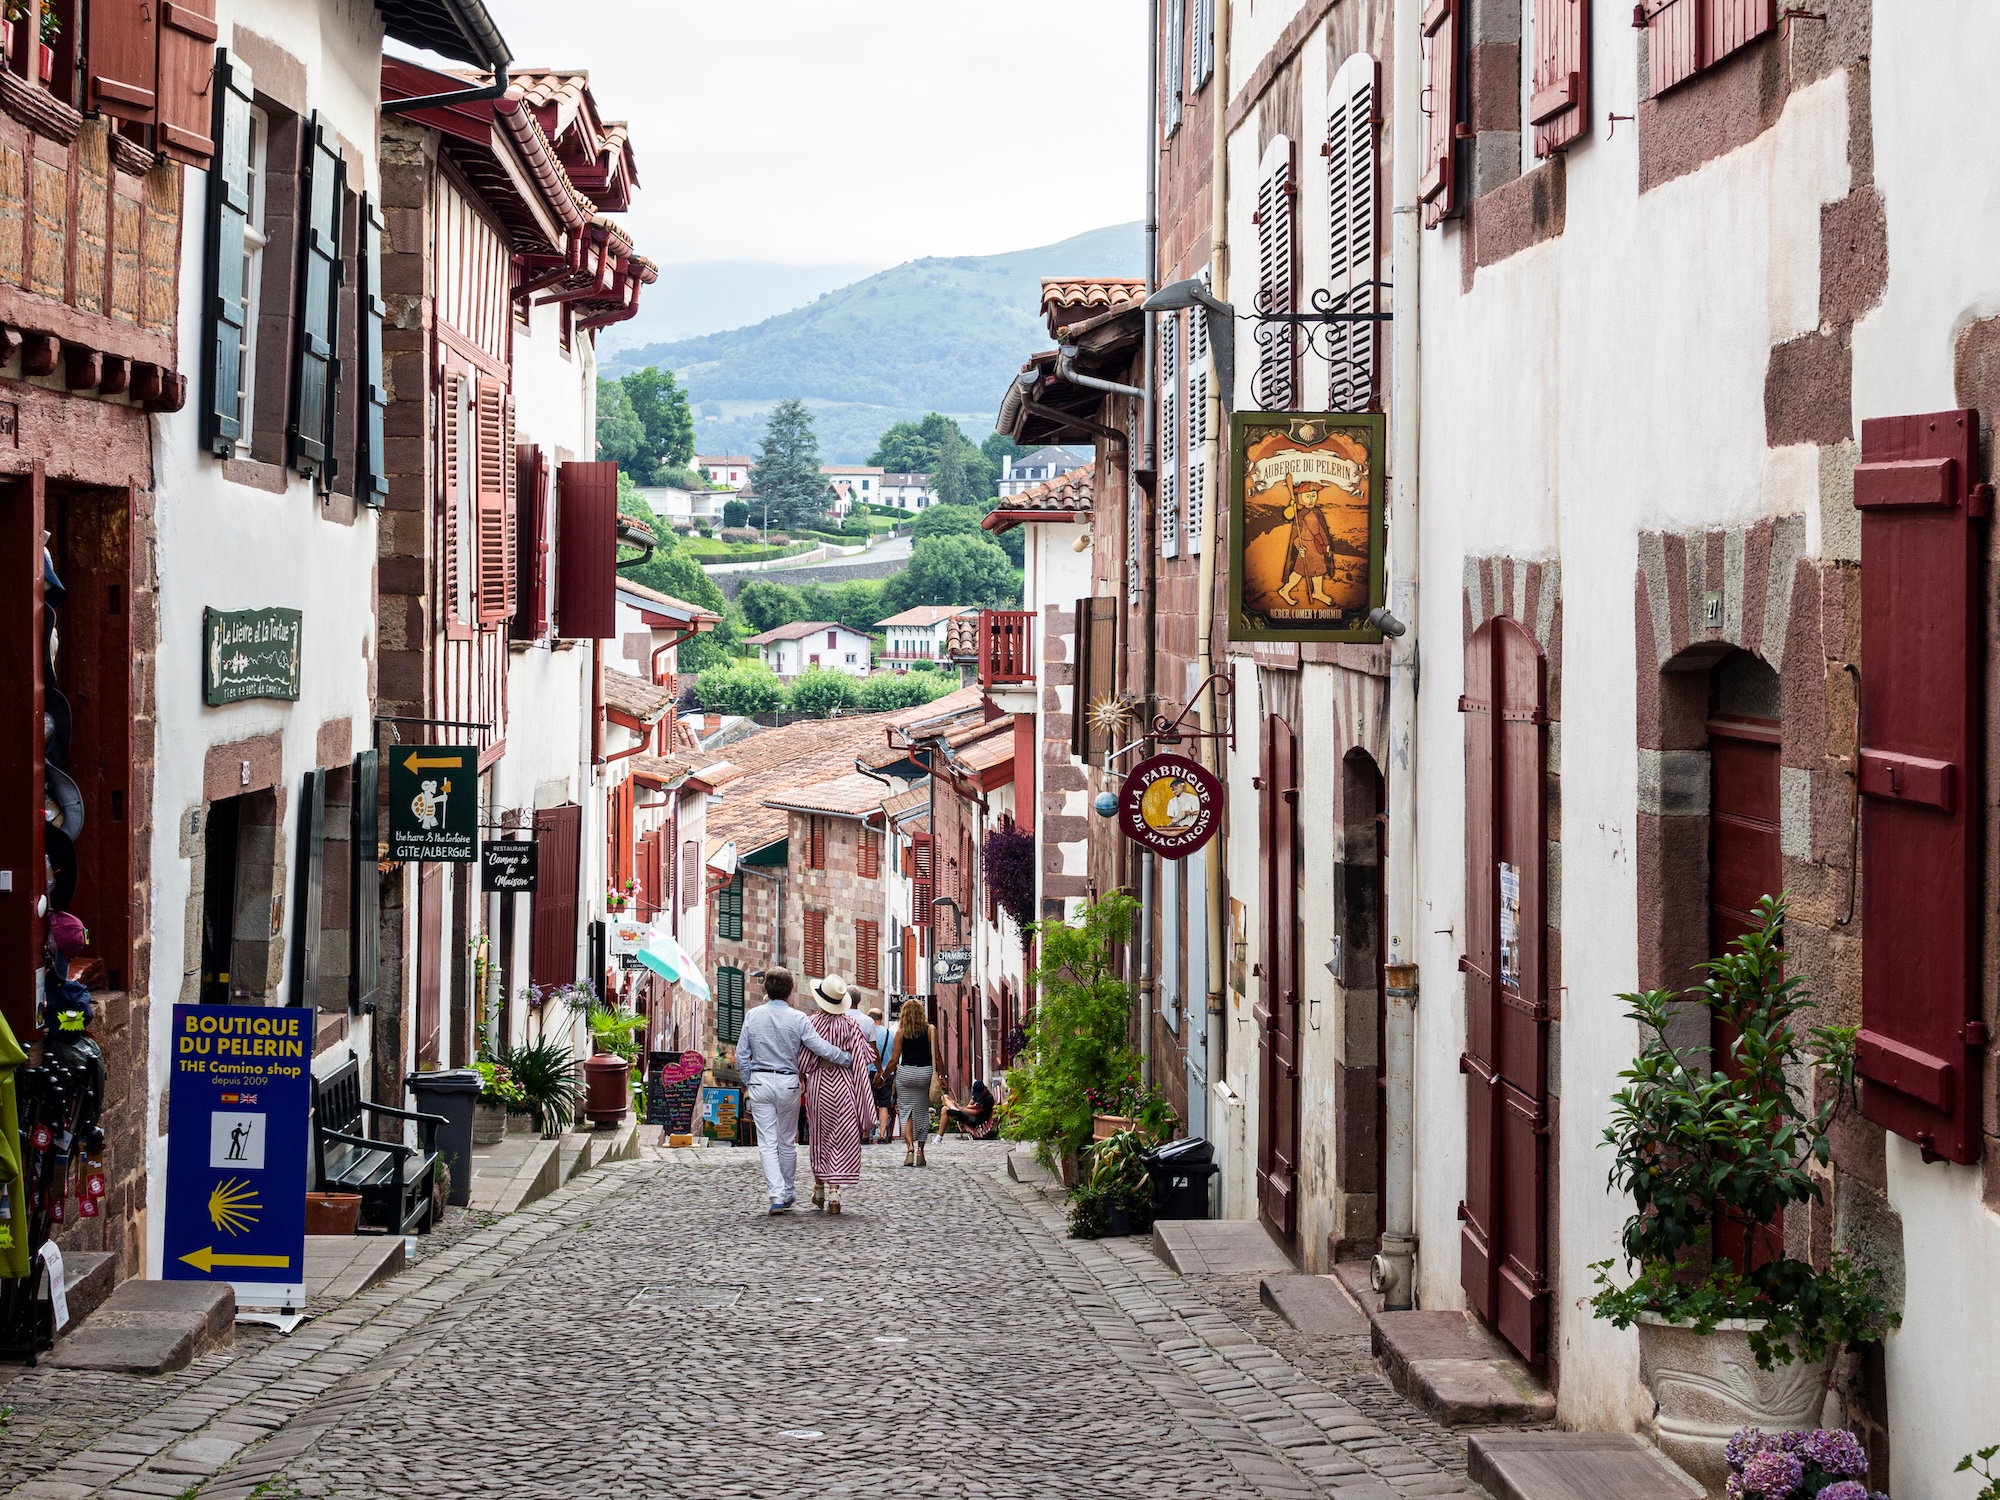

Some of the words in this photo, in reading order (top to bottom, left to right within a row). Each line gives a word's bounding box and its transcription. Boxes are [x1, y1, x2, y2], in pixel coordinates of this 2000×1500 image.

[1264, 459, 1301, 480] AUBERGE
[1303, 459, 1314, 472] DU
[1316, 459, 1351, 480] PELERIN
[1292, 609, 1312, 619] COMER
[1313, 609, 1317, 619] Y
[1318, 609, 1342, 619] DORMIR
[1708, 600, 1718, 618] 27
[223, 622, 231, 645] Le
[232, 622, 253, 643] Lièvre
[254, 621, 261, 643] et
[262, 620, 269, 642] La
[270, 618, 289, 642] Tortue
[258, 683, 265, 694] de
[1129, 789, 1143, 810] LA
[1141, 765, 1211, 803] FABRIQUE
[1132, 813, 1146, 832] DE
[1144, 809, 1211, 847] MACARONS
[445, 832, 471, 843] tortoise
[521, 854, 530, 865] à
[506, 864, 517, 875] la
[937, 951, 972, 960] CHAMBRES
[950, 963, 965, 972] Chez
[185, 1015, 300, 1037] BOUTIQUE
[179, 1036, 211, 1054] DU
[217, 1038, 303, 1058] PELERIN
[179, 1060, 206, 1073] THE
[209, 1061, 264, 1075] Camino
[267, 1062, 302, 1079] shop
[211, 1075, 241, 1087] depuis
[243, 1076, 269, 1086] 2009
